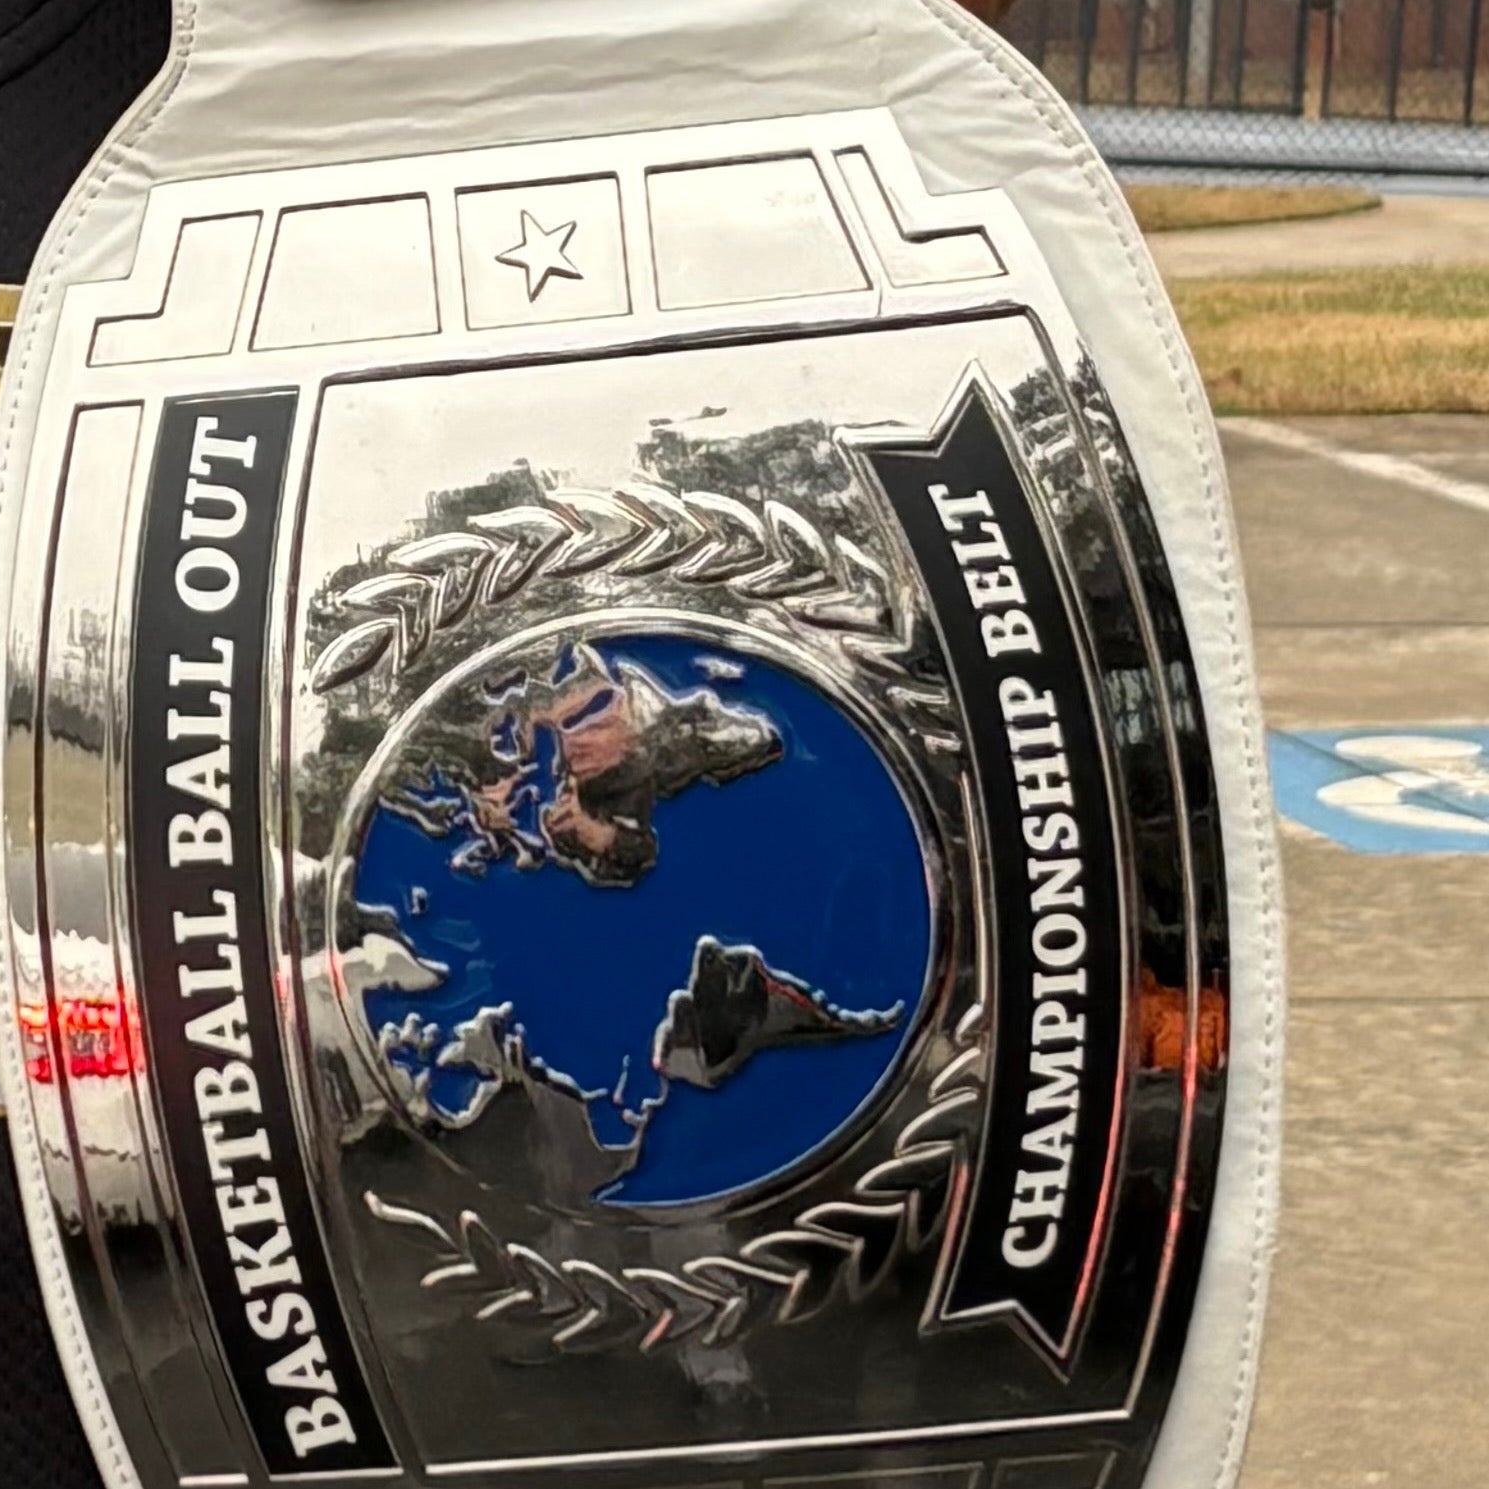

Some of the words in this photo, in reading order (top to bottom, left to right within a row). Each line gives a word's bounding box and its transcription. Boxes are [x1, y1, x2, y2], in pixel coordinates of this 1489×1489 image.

[174, 416, 258, 613] OUT
[929, 484, 1041, 657] BELT
[167, 637, 234, 868] BALL
[1000, 676, 1088, 1270] CHAMPIONSHIP
[173, 889, 356, 1457] BASKETBALL
